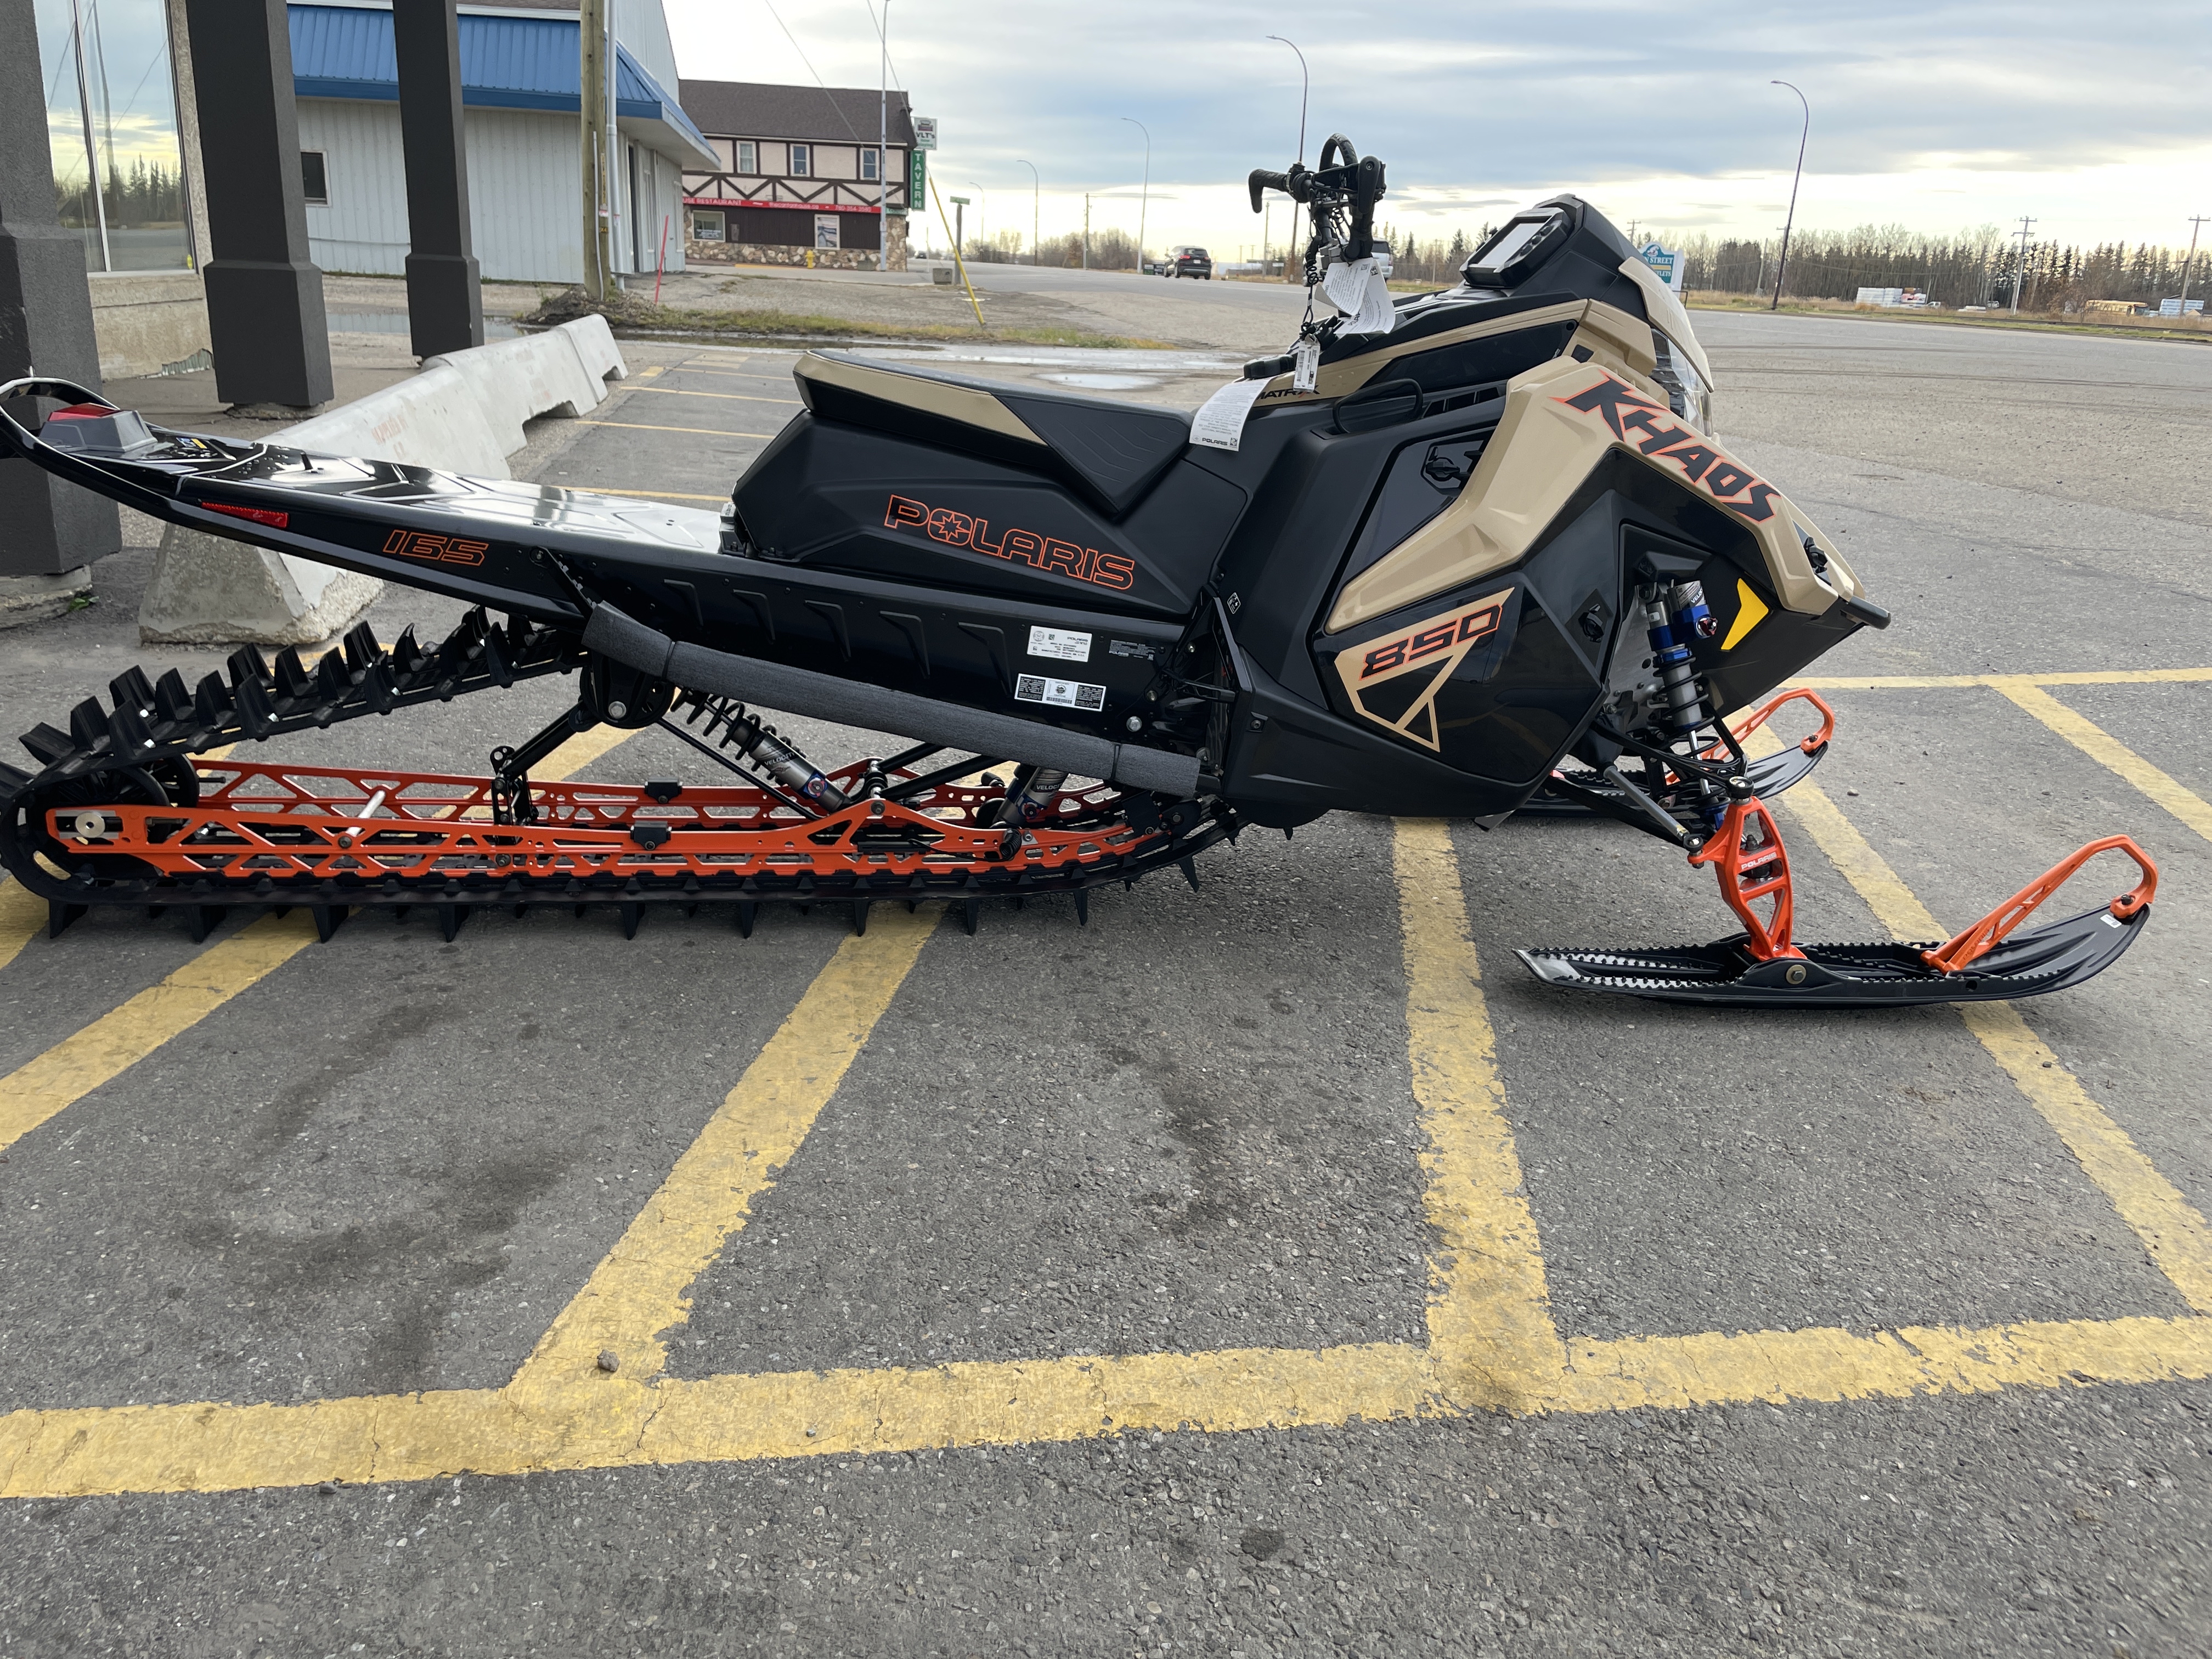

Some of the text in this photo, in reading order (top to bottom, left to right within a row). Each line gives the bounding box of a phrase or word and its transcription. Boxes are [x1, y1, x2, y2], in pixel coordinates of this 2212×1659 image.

[914, 153, 922, 208] TAVERN
[1201, 437, 1228, 446] POLARIS
[1549, 369, 1781, 524] KHAOS
[382, 529, 489, 567] 165
[884, 494, 1135, 590] POLARIS
[1359, 602, 1503, 681] 850
[1741, 851, 1778, 870] POLARIS
